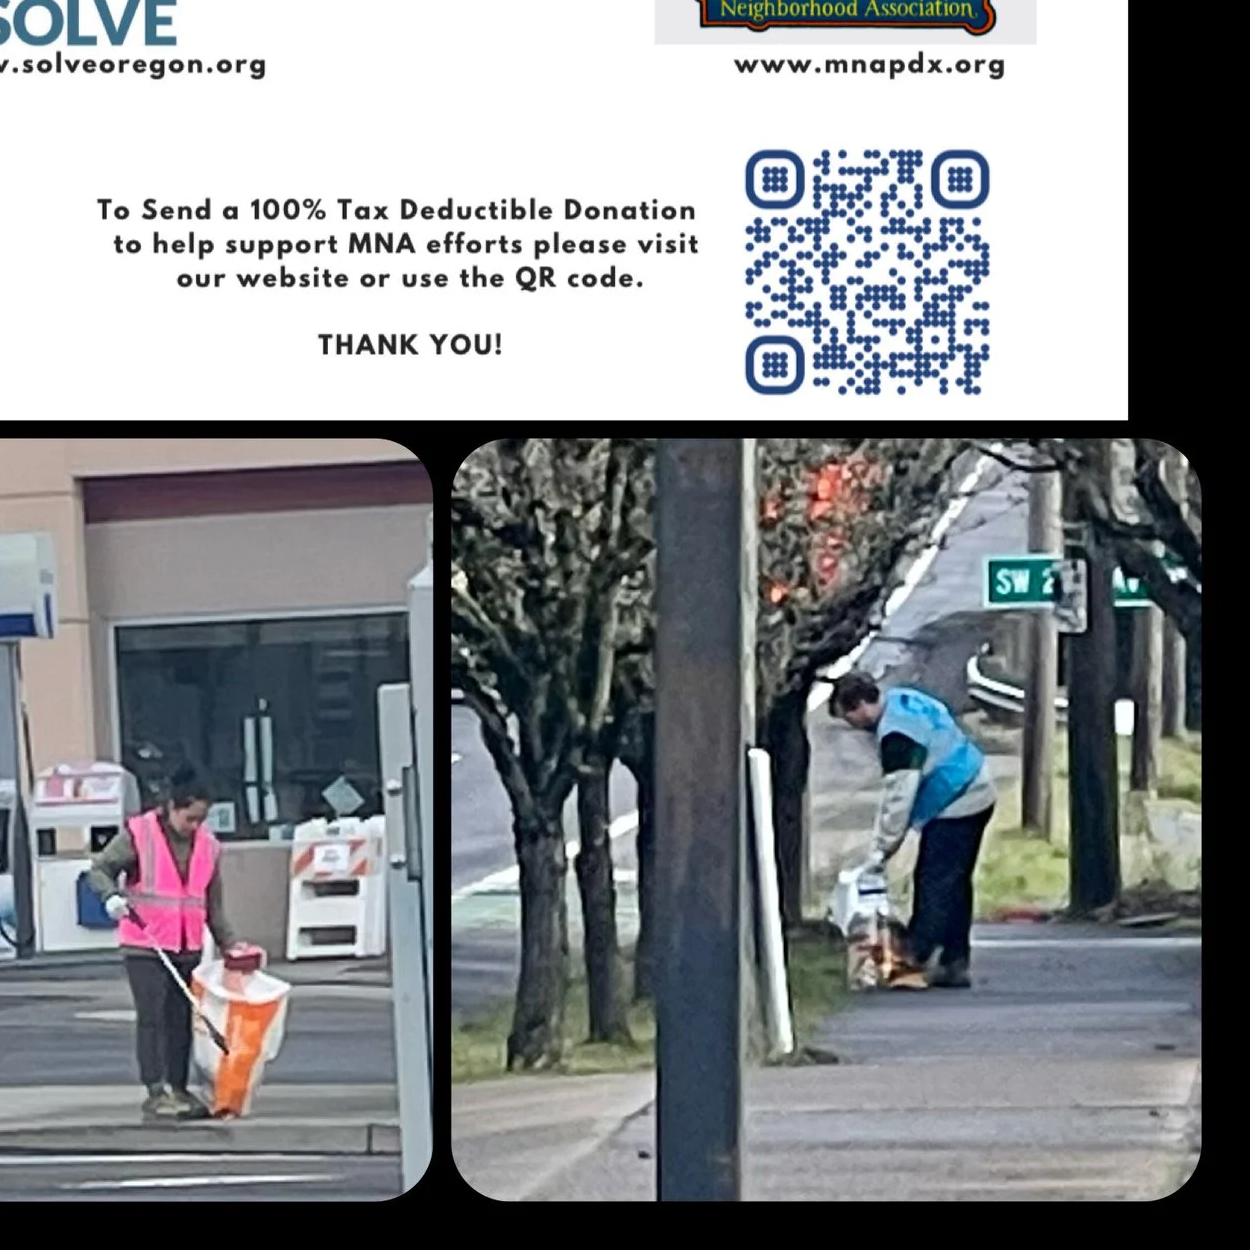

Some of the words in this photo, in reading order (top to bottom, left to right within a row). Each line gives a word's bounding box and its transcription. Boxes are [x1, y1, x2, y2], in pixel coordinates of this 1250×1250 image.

[734, 50, 1005, 80] www.mnapdx.org
[97, 198, 130, 220] To
[141, 197, 211, 220] Send
[222, 205, 239, 220] a
[250, 198, 327, 220] 100%
[337, 198, 389, 220] Tax
[400, 197, 553, 220] Deductible
[564, 198, 695, 220] Donation
[113, 235, 142, 254] to
[153, 231, 215, 260] help
[225, 235, 338, 260] support
[348, 232, 416, 254] MNA
[426, 231, 523, 254] efforts
[534, 231, 627, 260] please
[637, 232, 699, 254] visit
[177, 273, 226, 288] our
[236, 265, 349, 288] website
[360, 273, 391, 288] or
[402, 273, 449, 288] use
[459, 265, 505, 288] the
[515, 265, 557, 293] QR
[567, 265, 643, 288] code.
[318, 333, 419, 355] THANK
[429, 332, 502, 356] YOU!
[995, 567, 1030, 595] SW
